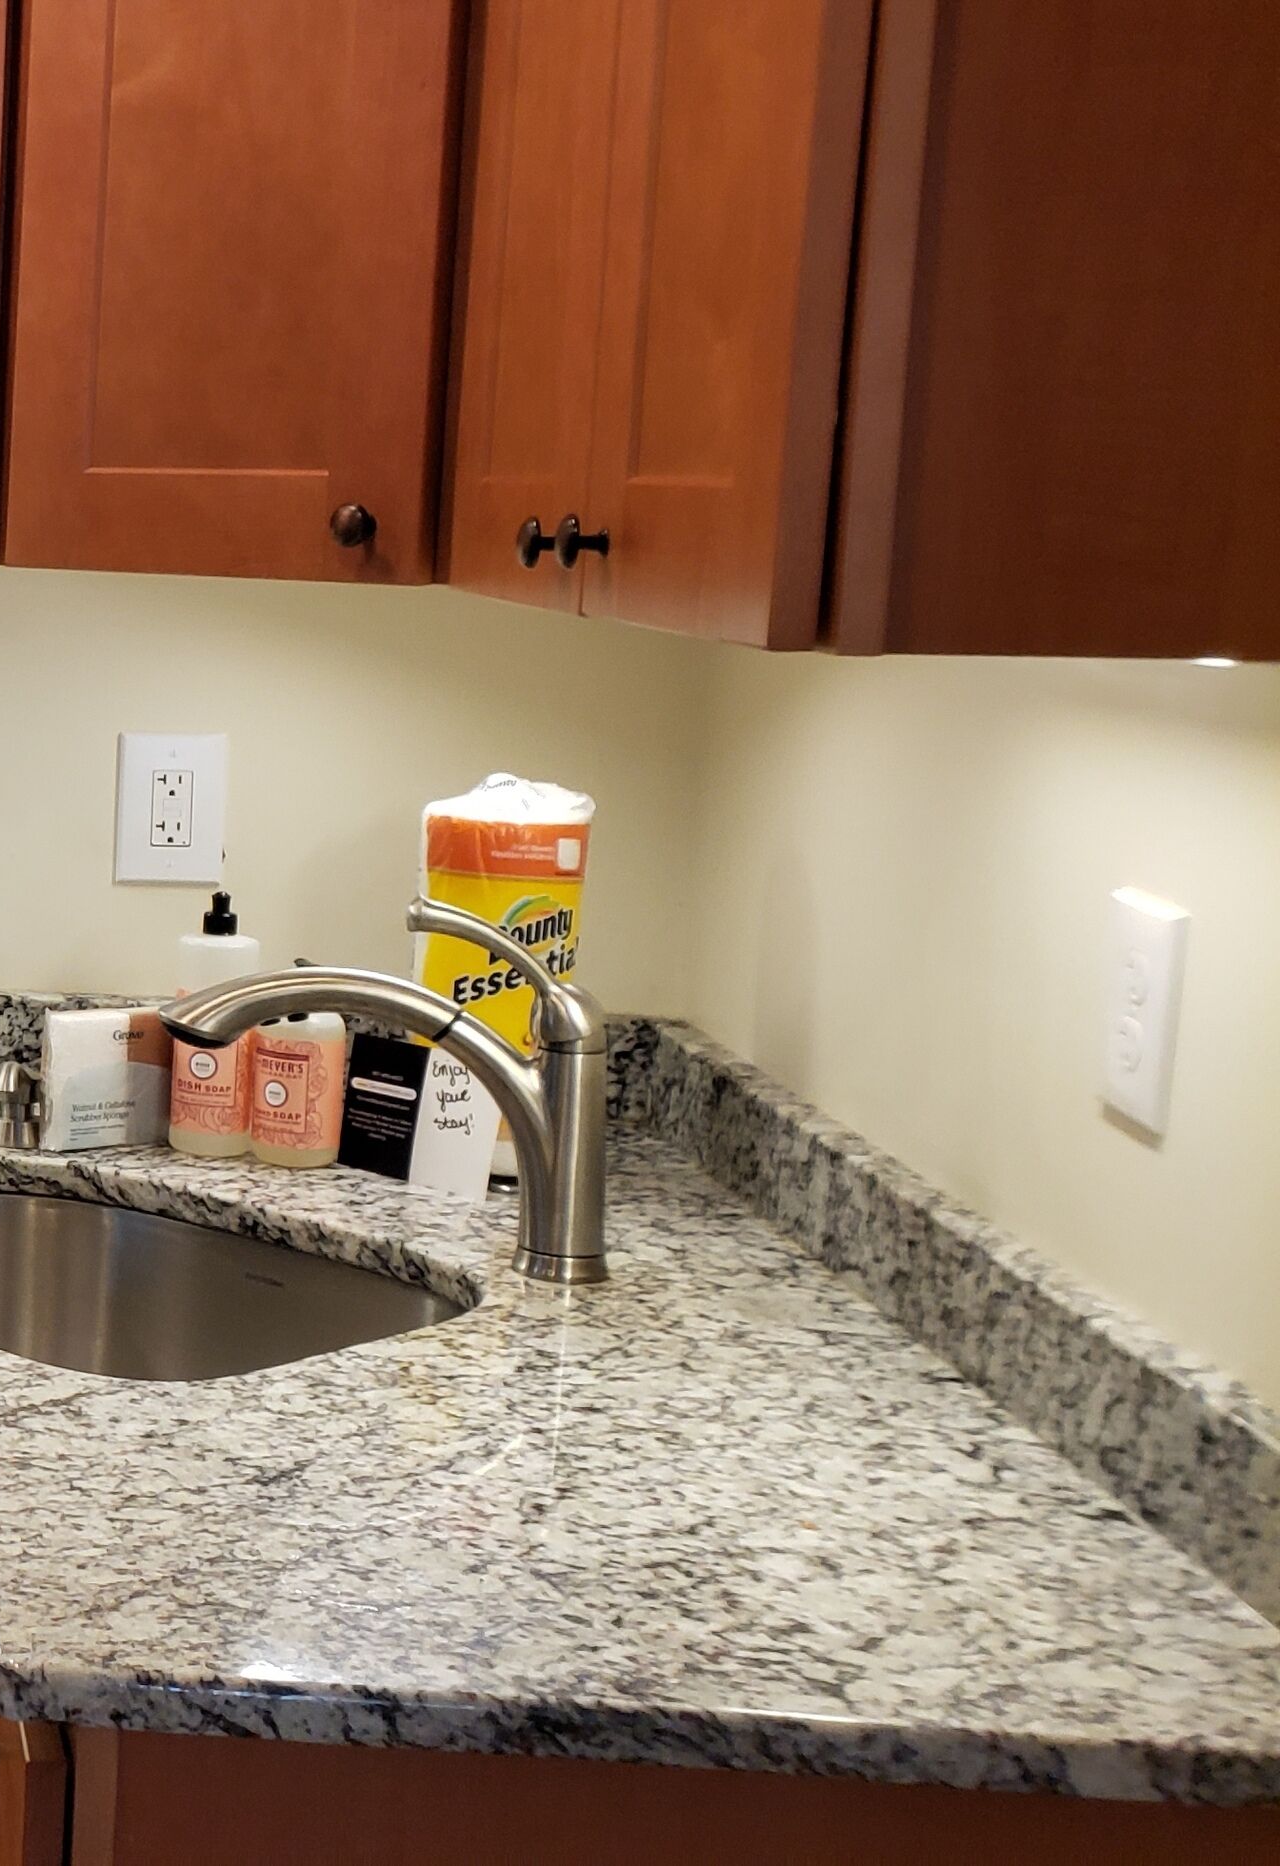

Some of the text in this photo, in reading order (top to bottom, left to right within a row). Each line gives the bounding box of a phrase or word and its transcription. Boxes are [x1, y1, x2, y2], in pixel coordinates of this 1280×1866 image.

[490, 908, 573, 962] ounty
[432, 1060, 471, 1087] Enjoy
[177, 1078, 202, 1092] DISH
[204, 1086, 232, 1094] SOAP
[273, 1110, 302, 1121] SOAP
[433, 1113, 476, 1136] stay!
